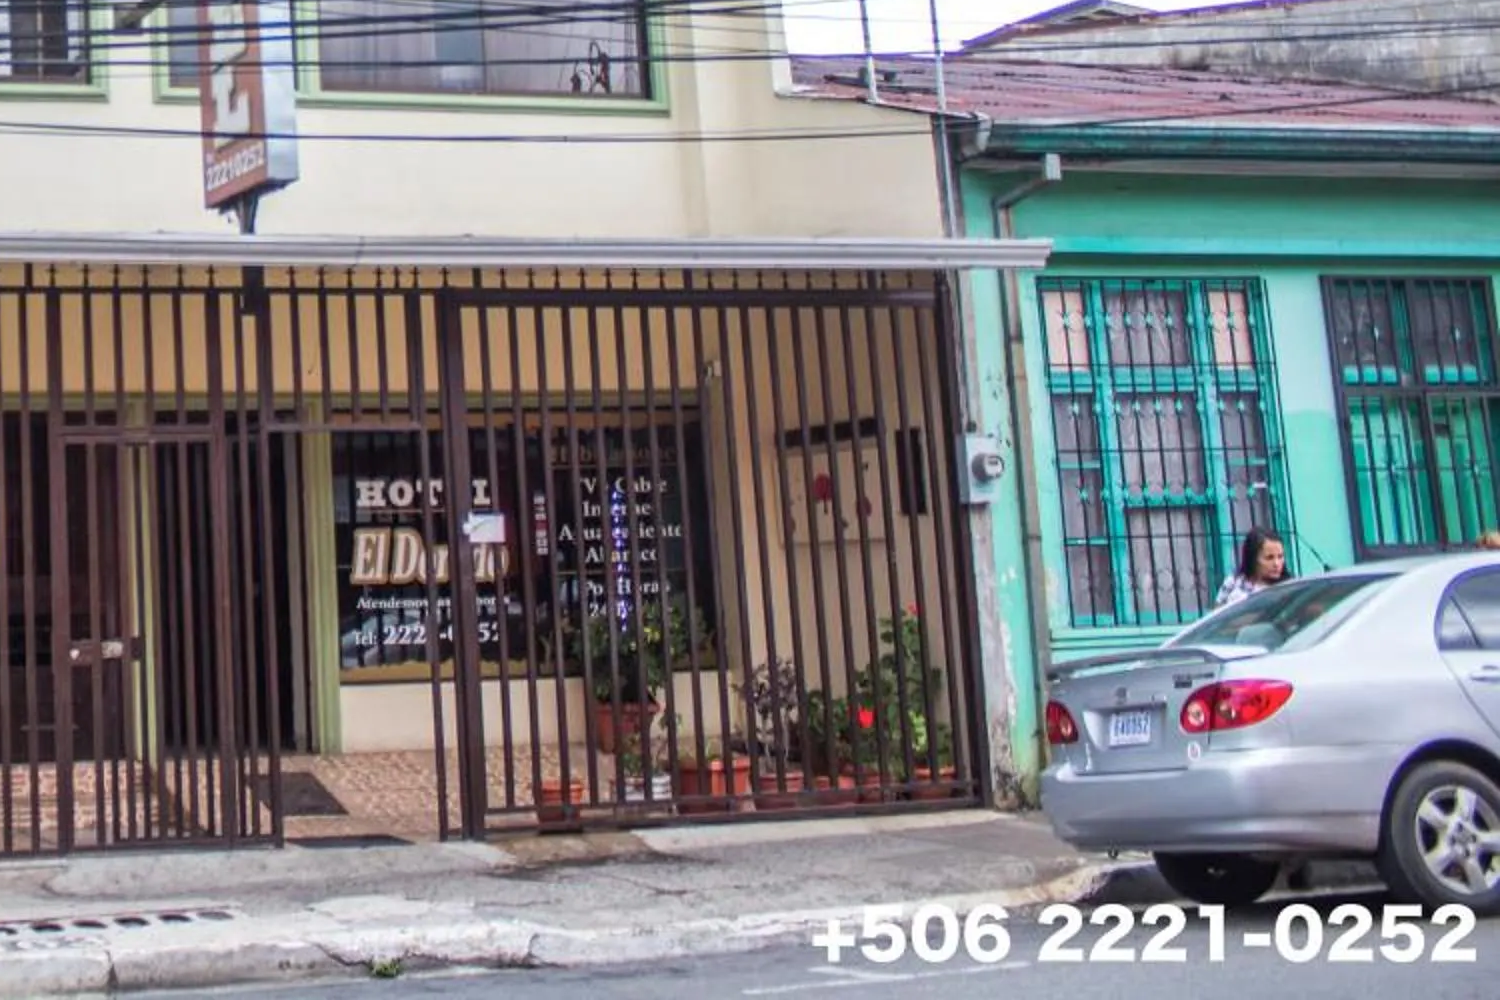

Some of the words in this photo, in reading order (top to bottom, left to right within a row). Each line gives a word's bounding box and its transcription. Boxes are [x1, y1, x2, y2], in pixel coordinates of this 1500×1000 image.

[355, 479, 491, 507] HOTL
[614, 476, 668, 494] Cbe
[582, 501, 657, 518] Inere
[354, 531, 387, 582] El
[393, 532, 510, 582] Doro
[383, 622, 501, 645] 222-5
